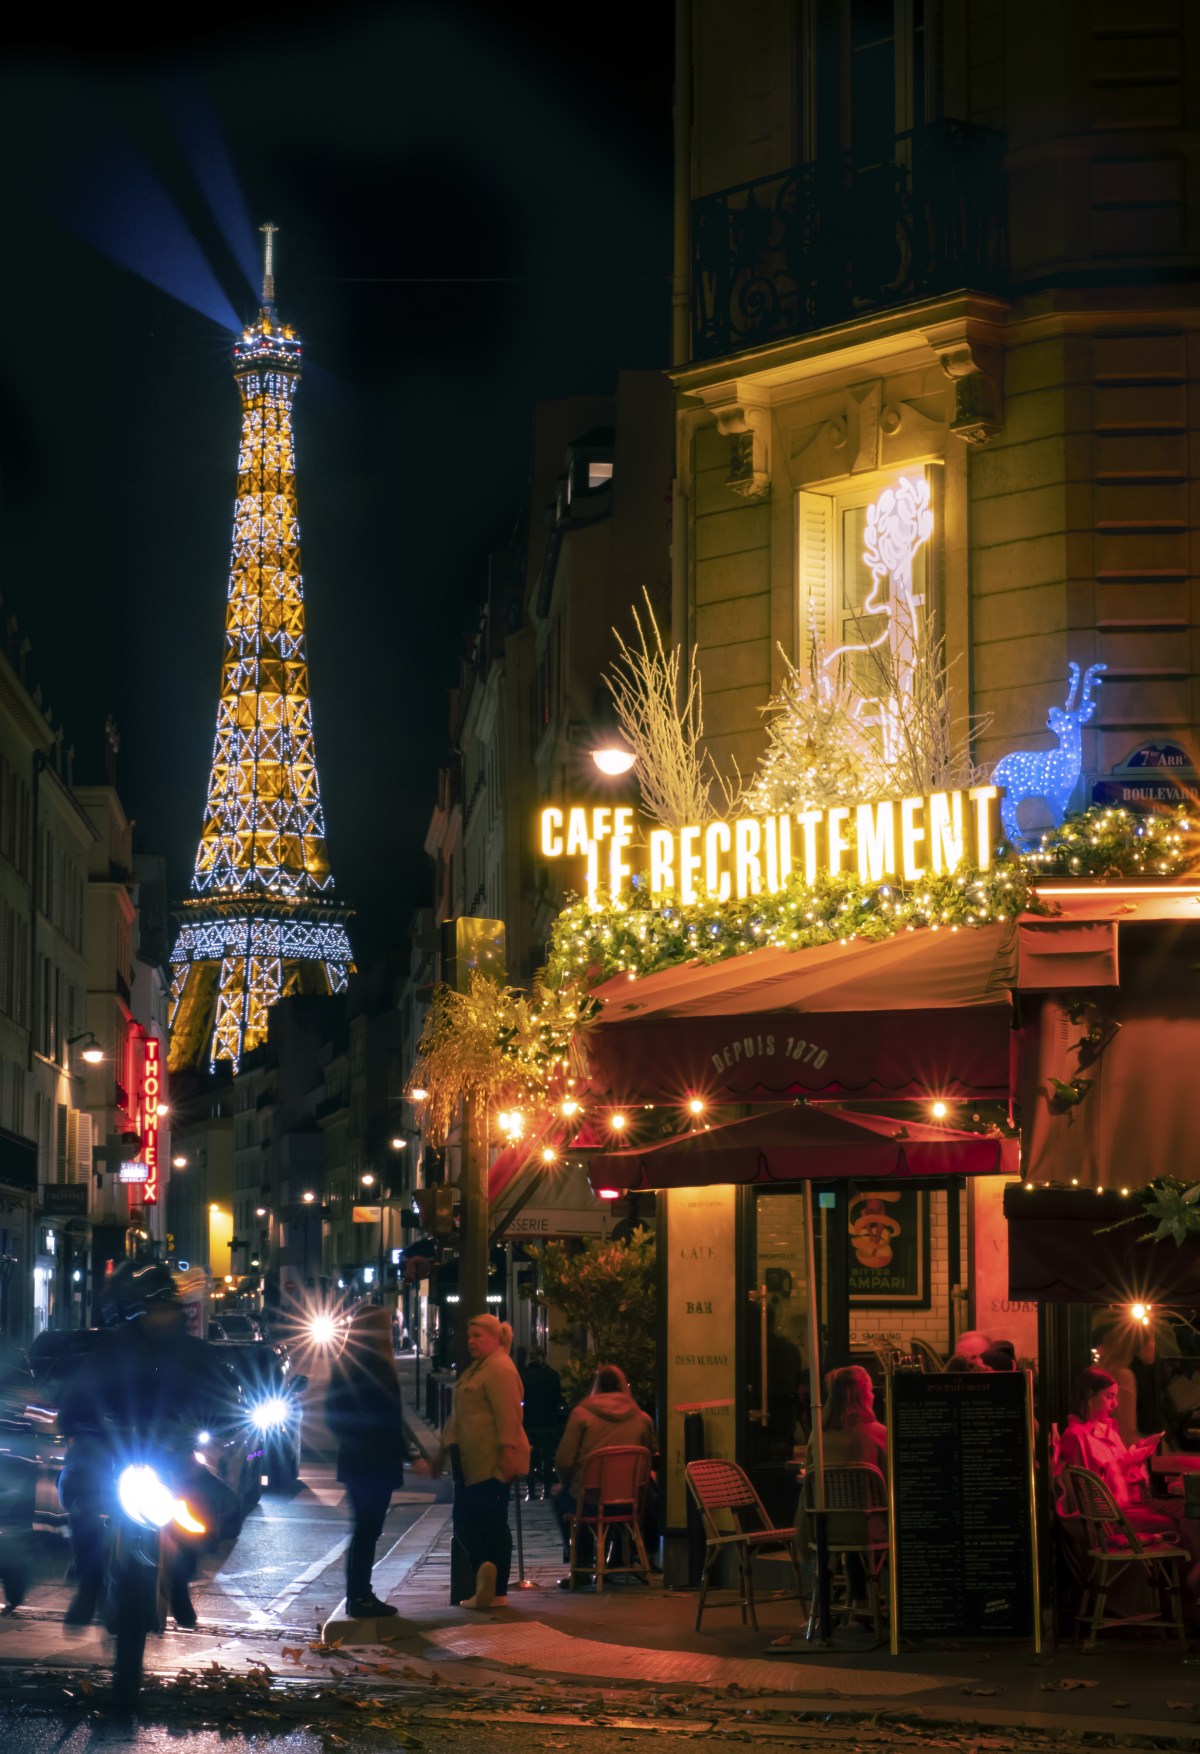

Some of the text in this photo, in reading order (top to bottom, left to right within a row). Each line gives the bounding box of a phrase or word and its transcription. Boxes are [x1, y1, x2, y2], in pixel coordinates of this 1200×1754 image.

[1122, 787, 1199, 801] BOULEVARD
[541, 807, 634, 857] CAFE
[587, 785, 1000, 913] LE RECRUTEMENT
[711, 1034, 829, 1074] DEPUIS 1870
[852, 1268, 890, 1276] BITTER
[849, 1277, 905, 1288] AMPARI
[686, 1301, 713, 1314] BAR
[991, 1299, 1039, 1312] SODAS
[862, 1332, 901, 1340] SMOKING
[675, 1355, 729, 1366] RESTAURANT
